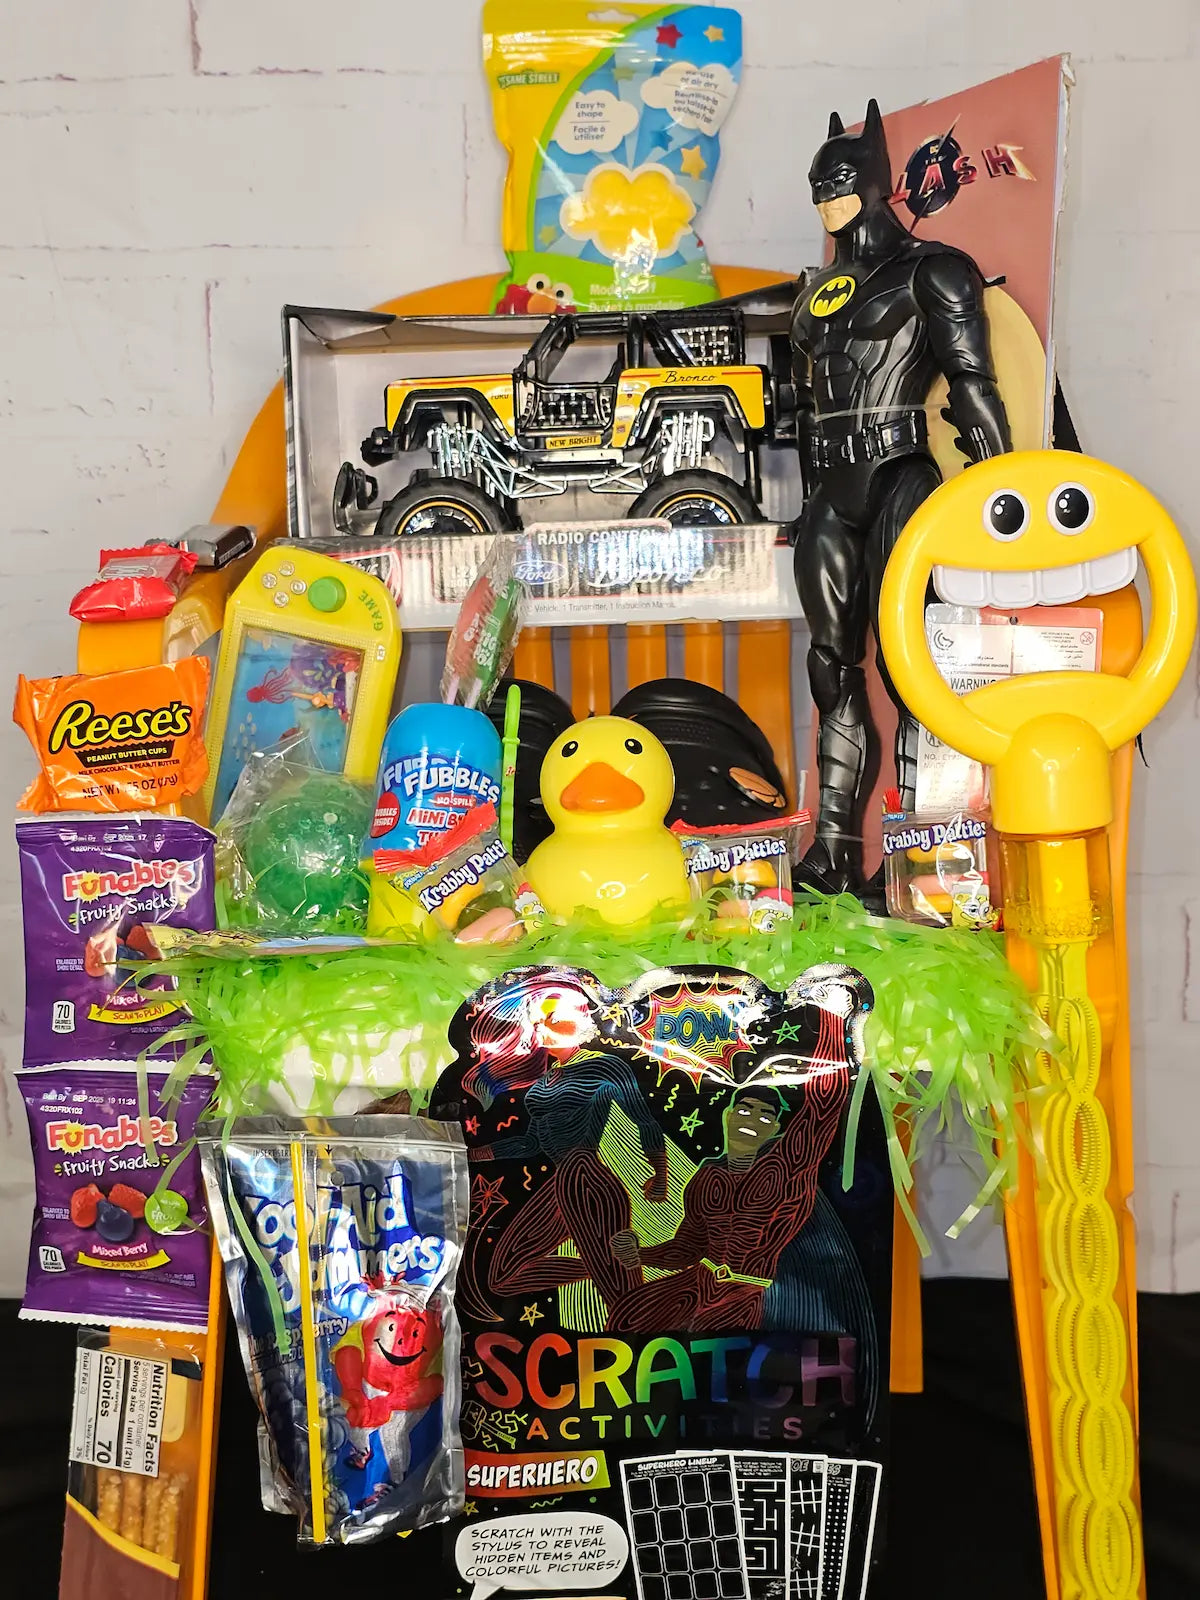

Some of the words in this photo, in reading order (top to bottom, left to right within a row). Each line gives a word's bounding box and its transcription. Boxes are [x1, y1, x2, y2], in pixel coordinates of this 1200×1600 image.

[575, 102, 595, 110] Easy
[574, 133, 604, 141] utiliser
[888, 143, 1037, 205] LASH
[664, 370, 718, 384] Bronco
[568, 437, 598, 446] BRIGHT
[537, 532, 585, 545] RADIO
[513, 563, 558, 582] Ford
[49, 701, 192, 753] Reese's
[87, 753, 117, 763] PEANUT
[119, 750, 147, 759] BUTTER
[148, 747, 168, 755] CUPS
[94, 765, 127, 774] CHOCOLATE
[135, 761, 156, 769] PEANUT
[158, 759, 180, 767] BUTTER
[141, 779, 157, 790] OZ
[404, 766, 500, 804] FUBBLES
[685, 850, 731, 879] rabby
[731, 838, 787, 867] Patties
[419, 863, 479, 914] Krabby
[467, 839, 509, 875] Patti
[125, 893, 178, 915] Snacks
[57, 1004, 70, 1018] 70
[73, 1094, 88, 1102] SEP
[42, 1248, 57, 1262] 70
[92, 1244, 122, 1257] Mixed
[124, 1242, 148, 1257] Berry
[131, 1360, 141, 1393] Serving
[474, 1333, 857, 1410] SCRATCH
[100, 1355, 116, 1418] Calories
[138, 1366, 149, 1399] servings
[129, 1394, 137, 1413] size
[148, 1364, 165, 1429] Nutrition
[137, 1400, 146, 1413] per
[126, 1426, 134, 1445] unit
[135, 1413, 145, 1447] container
[96, 1440, 113, 1464] 70
[123, 1446, 134, 1469] (21g)
[144, 1433, 158, 1473] Facts
[467, 1457, 599, 1489] SUPERHERO
[637, 1459, 687, 1471] SUPERHERO
[688, 1457, 718, 1467] LINEUP
[471, 1527, 535, 1539] SCRATCH
[540, 1526, 573, 1538] WITH
[579, 1525, 605, 1535] THE
[471, 1540, 522, 1551] STYLUS
[528, 1540, 548, 1550] TO
[553, 1537, 606, 1549] REVEAL
[475, 1553, 526, 1564] HIDDEN
[530, 1551, 573, 1562] ITEMS
[578, 1549, 606, 1560] AND
[465, 1565, 542, 1577] COLORFUL
[547, 1560, 621, 1574] PICTURES!
